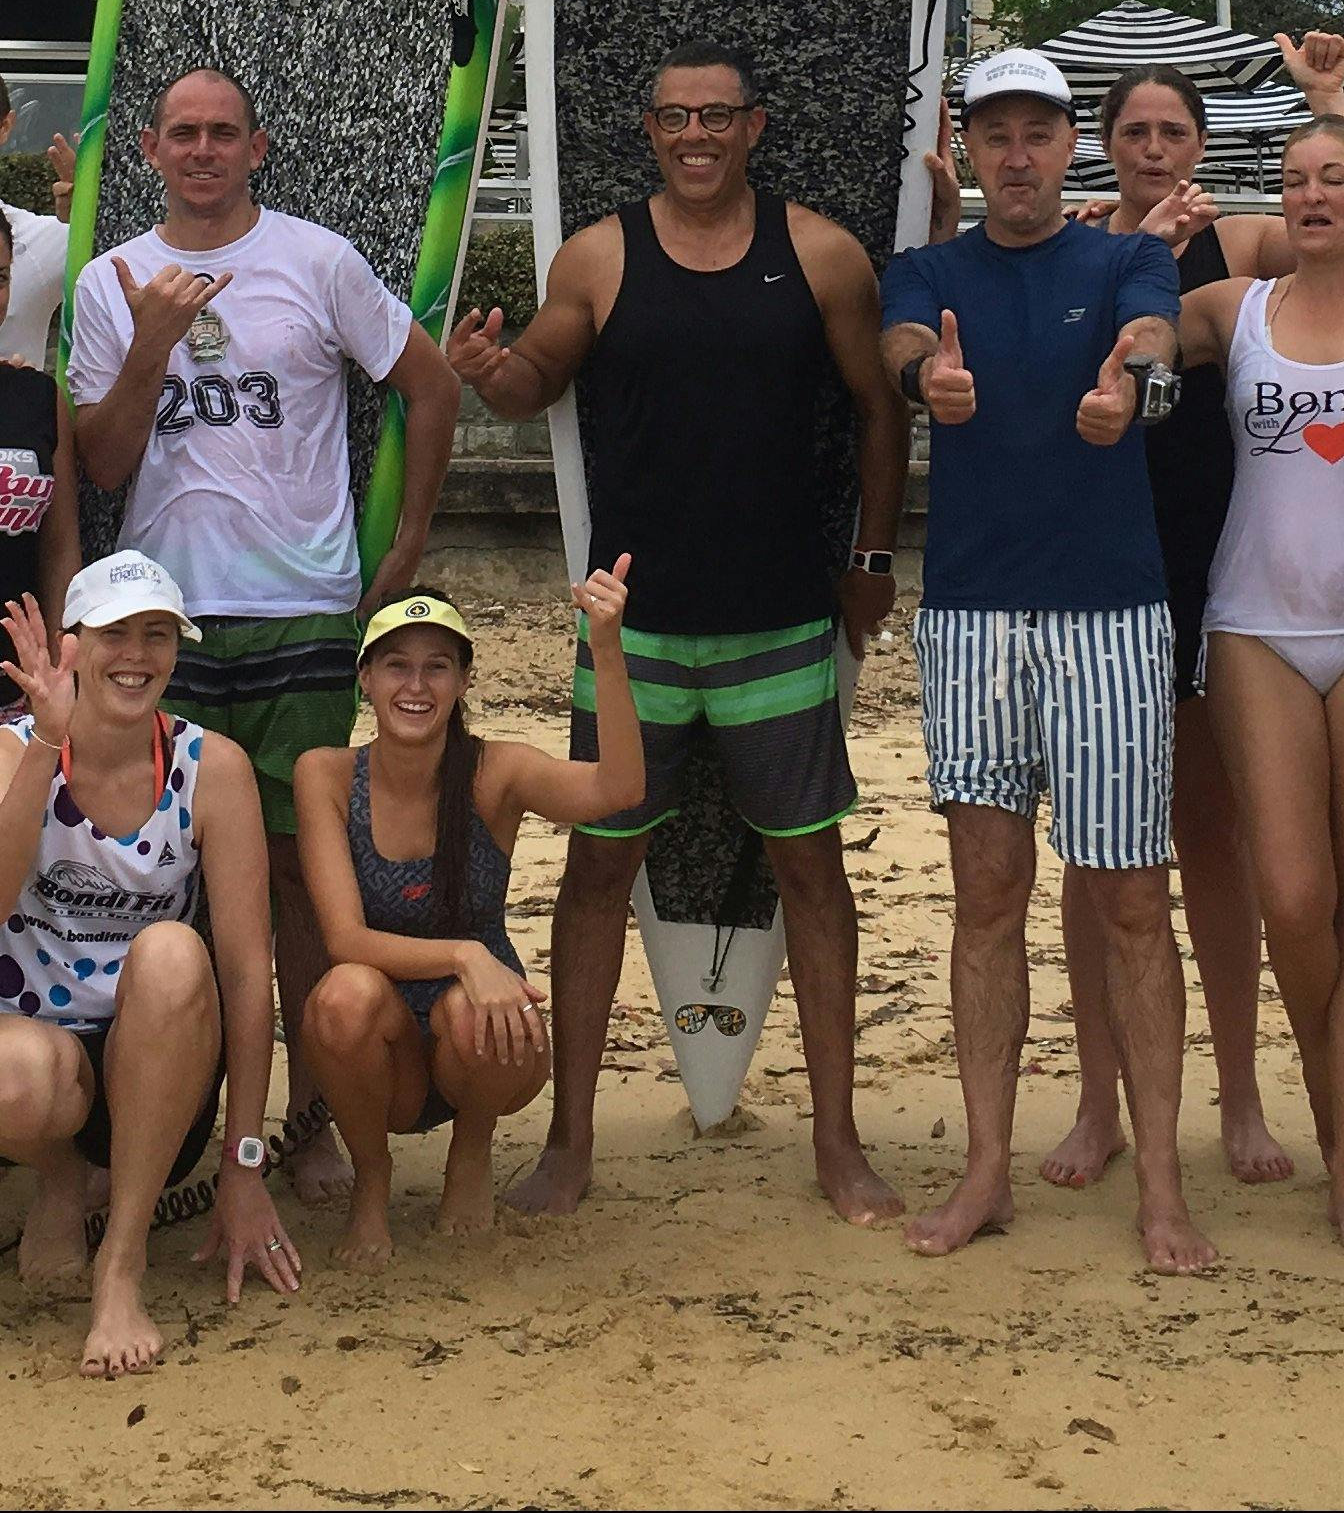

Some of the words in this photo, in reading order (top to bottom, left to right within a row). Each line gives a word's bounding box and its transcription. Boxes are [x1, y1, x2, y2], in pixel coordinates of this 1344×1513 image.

[156, 371, 285, 436] 203
[1251, 418, 1280, 430] with
[23, 913, 137, 943] www.bondifit.
